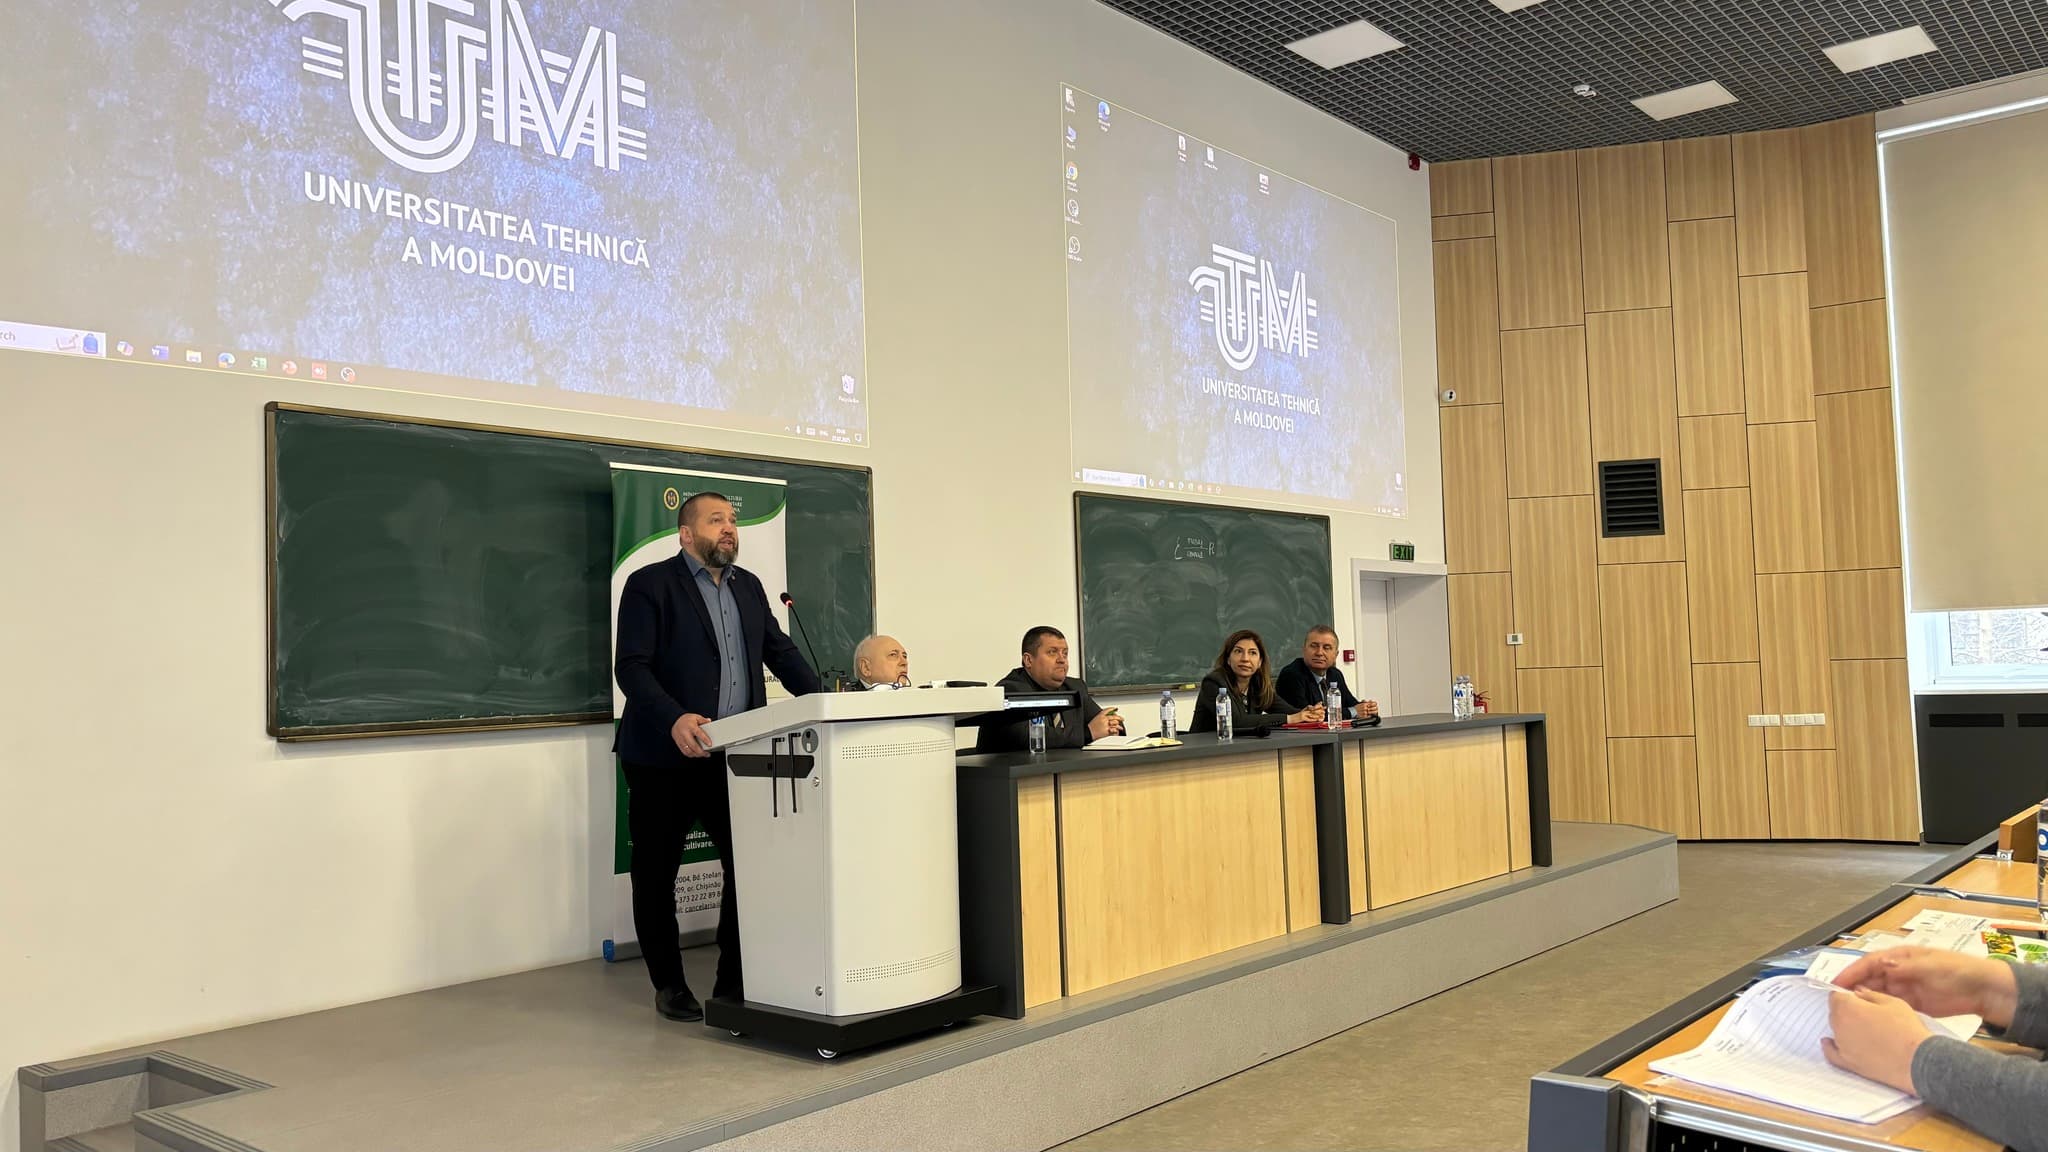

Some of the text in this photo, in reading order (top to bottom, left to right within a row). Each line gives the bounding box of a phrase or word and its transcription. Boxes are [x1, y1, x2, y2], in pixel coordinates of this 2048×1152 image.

[304, 171, 651, 269] UNIVERSITATEA TEHNICĂ
[401, 236, 576, 293] A MOLDOVEI
[1202, 376, 1321, 416] UNIVERSITATEA TEHNICĂ
[1234, 408, 1295, 433] A MOLDOVEI
[1394, 546, 1413, 560] EXIT
